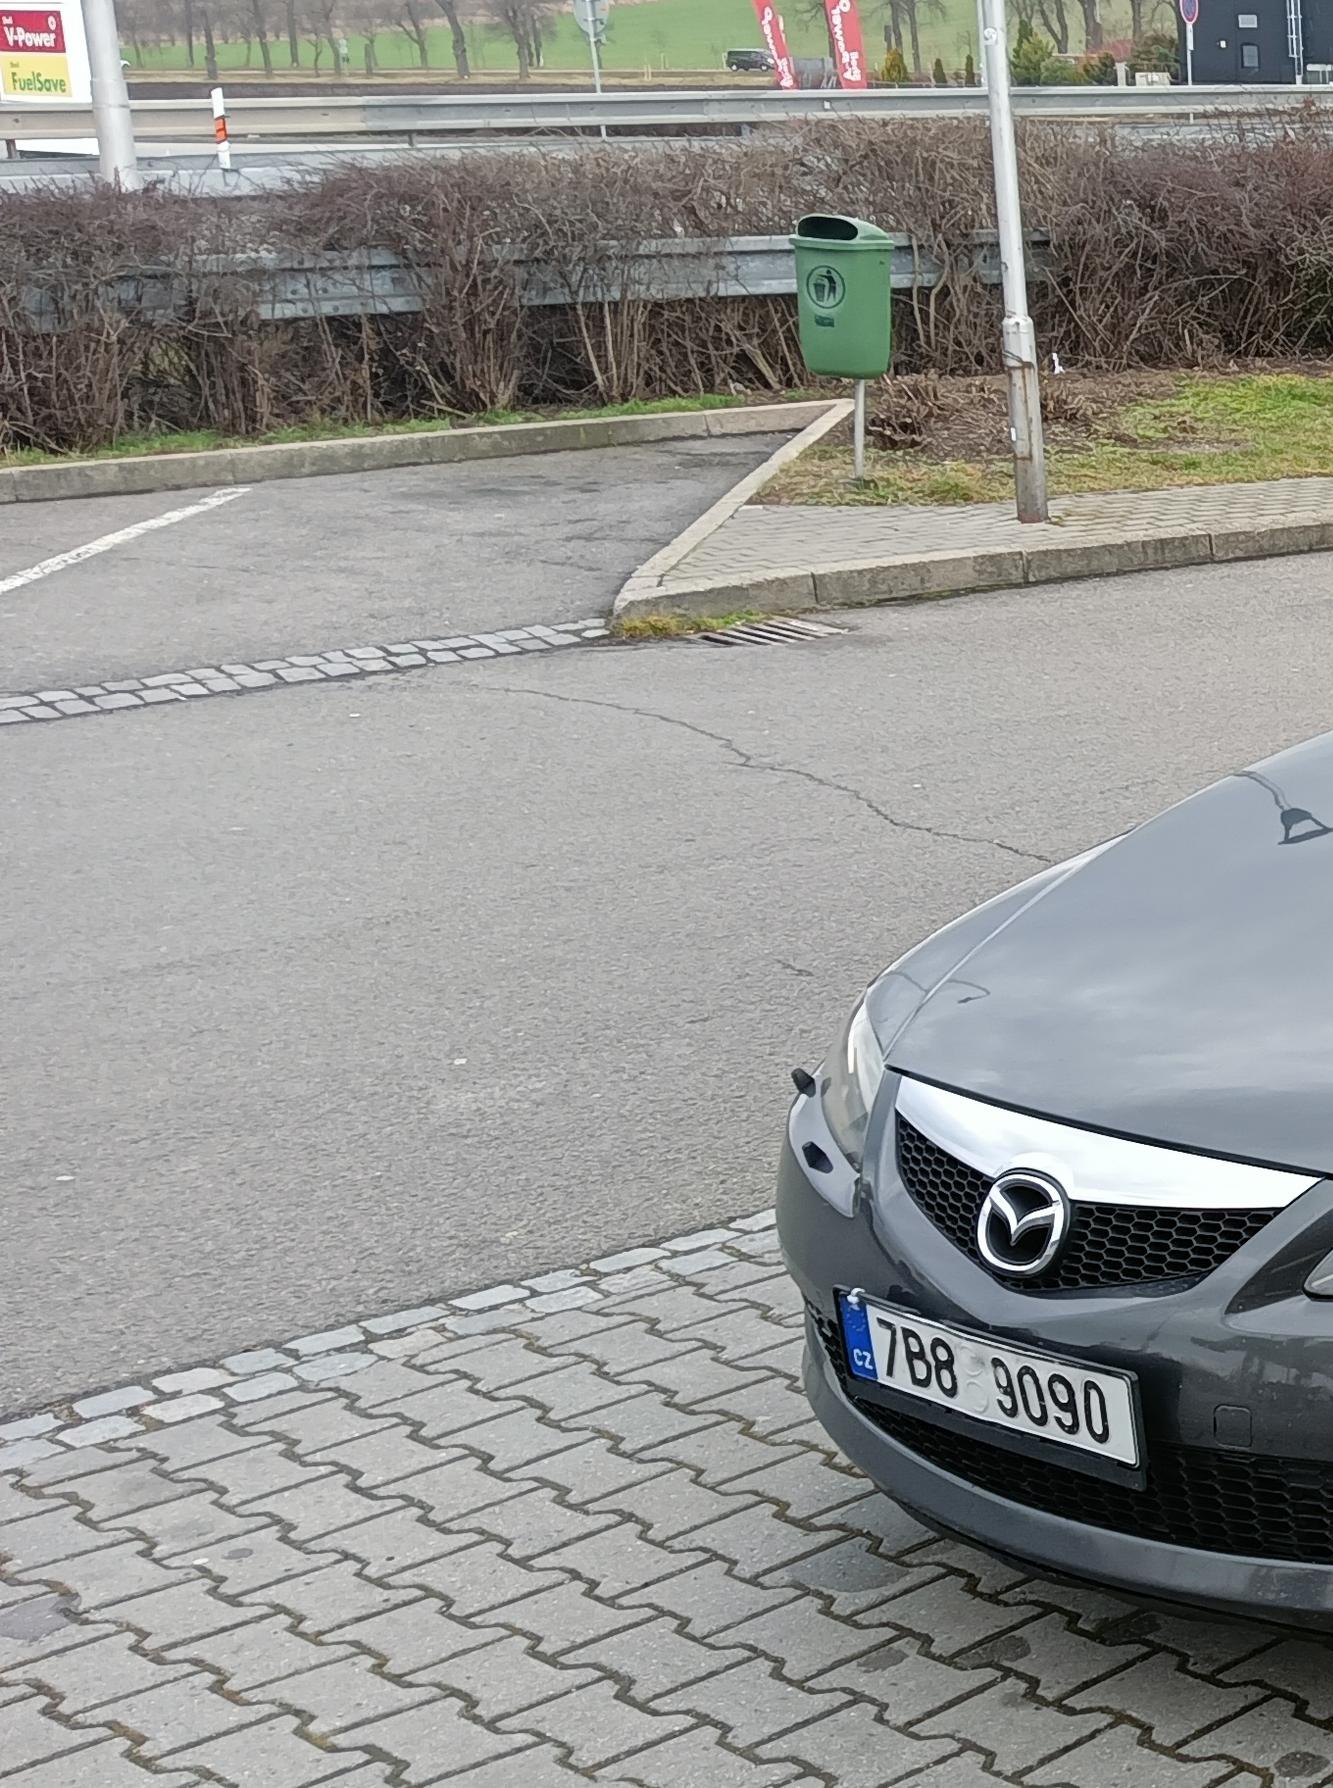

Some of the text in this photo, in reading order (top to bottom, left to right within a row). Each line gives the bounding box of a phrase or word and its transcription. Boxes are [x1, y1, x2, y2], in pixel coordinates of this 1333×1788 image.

[3, 26, 56, 47] V-Power
[11, 70, 67, 93] FuelSave
[853, 1348, 874, 1370] CZ
[876, 1316, 1110, 1445] 7B8 9090
